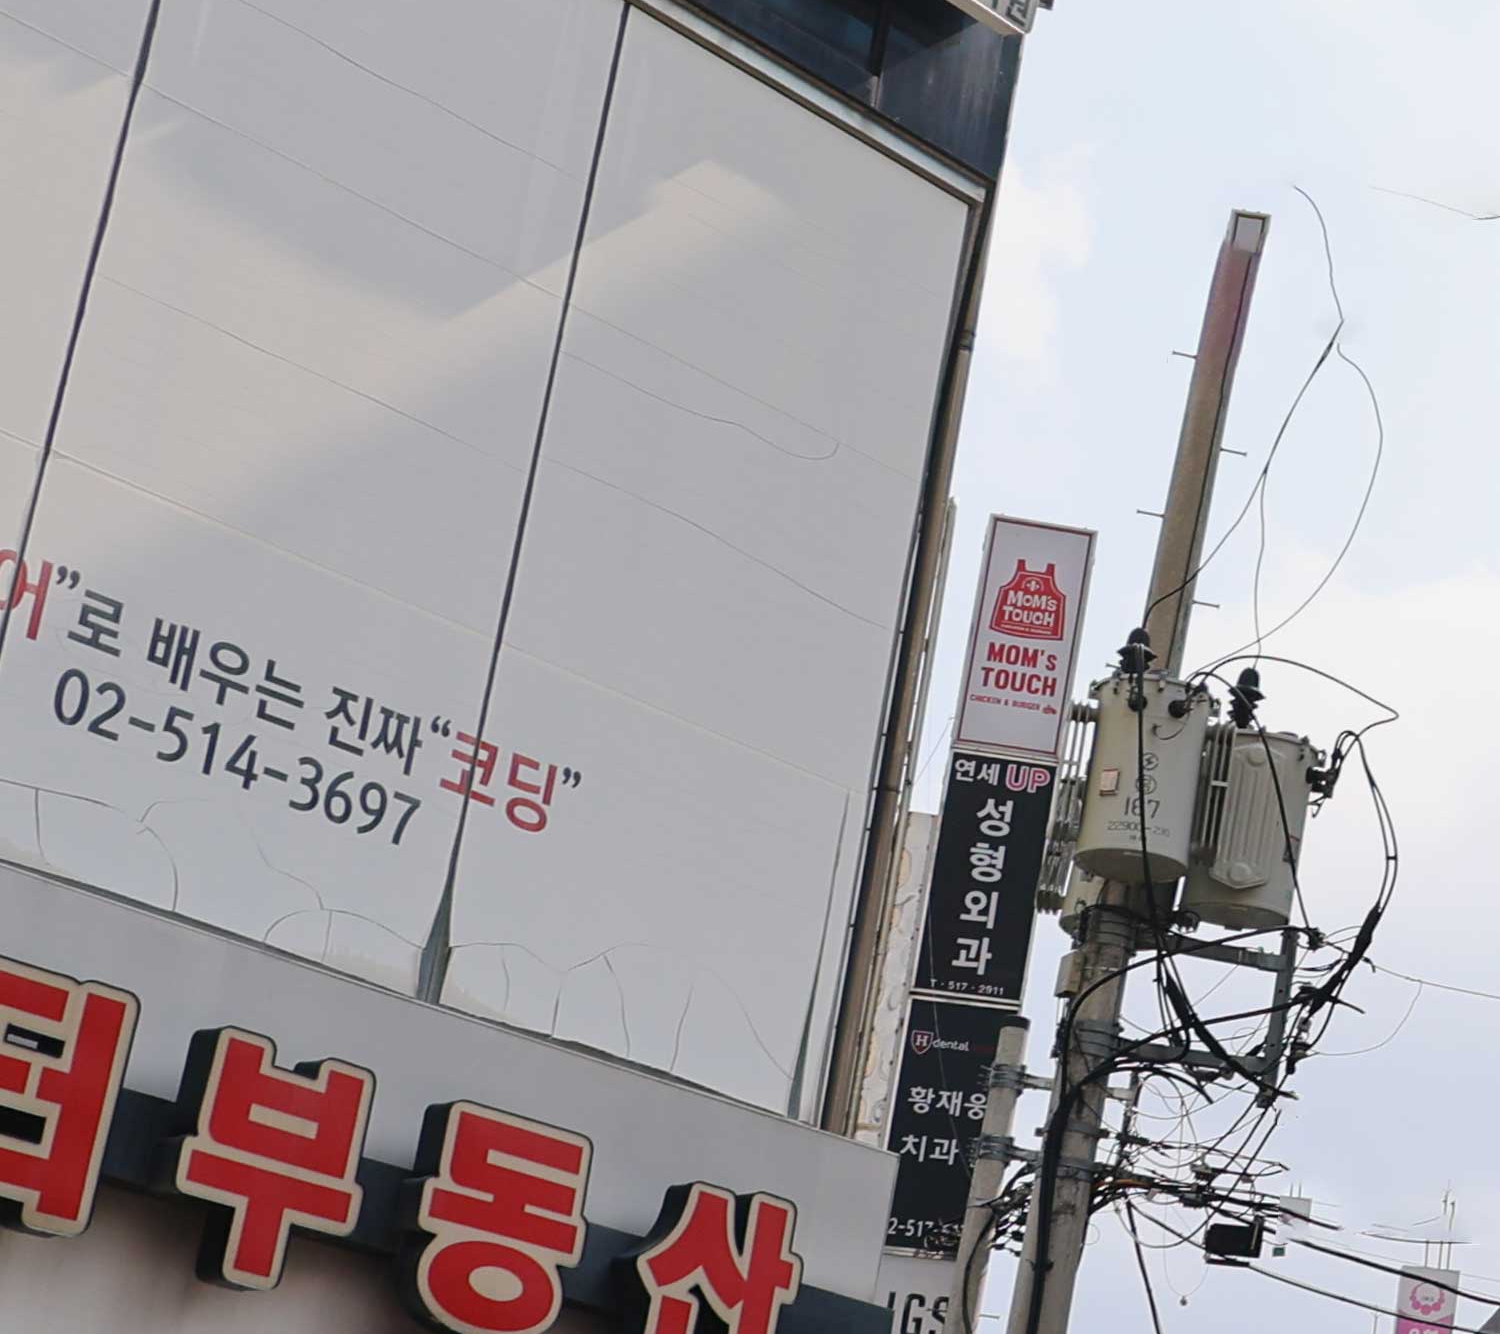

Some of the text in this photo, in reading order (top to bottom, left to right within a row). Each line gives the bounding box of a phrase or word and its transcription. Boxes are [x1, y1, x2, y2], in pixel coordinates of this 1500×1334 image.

[1002, 603, 1055, 628] TOUCH
[147, 615, 304, 732] 배우는
[980, 666, 1057, 696] TOUCH
[53, 668, 422, 845] 02-514-3697
[954, 759, 1051, 794] 연세 UP
[951, 797, 1014, 976] 성형외과
[932, 1037, 969, 1051] dental
[901, 1135, 959, 1165] 치과
